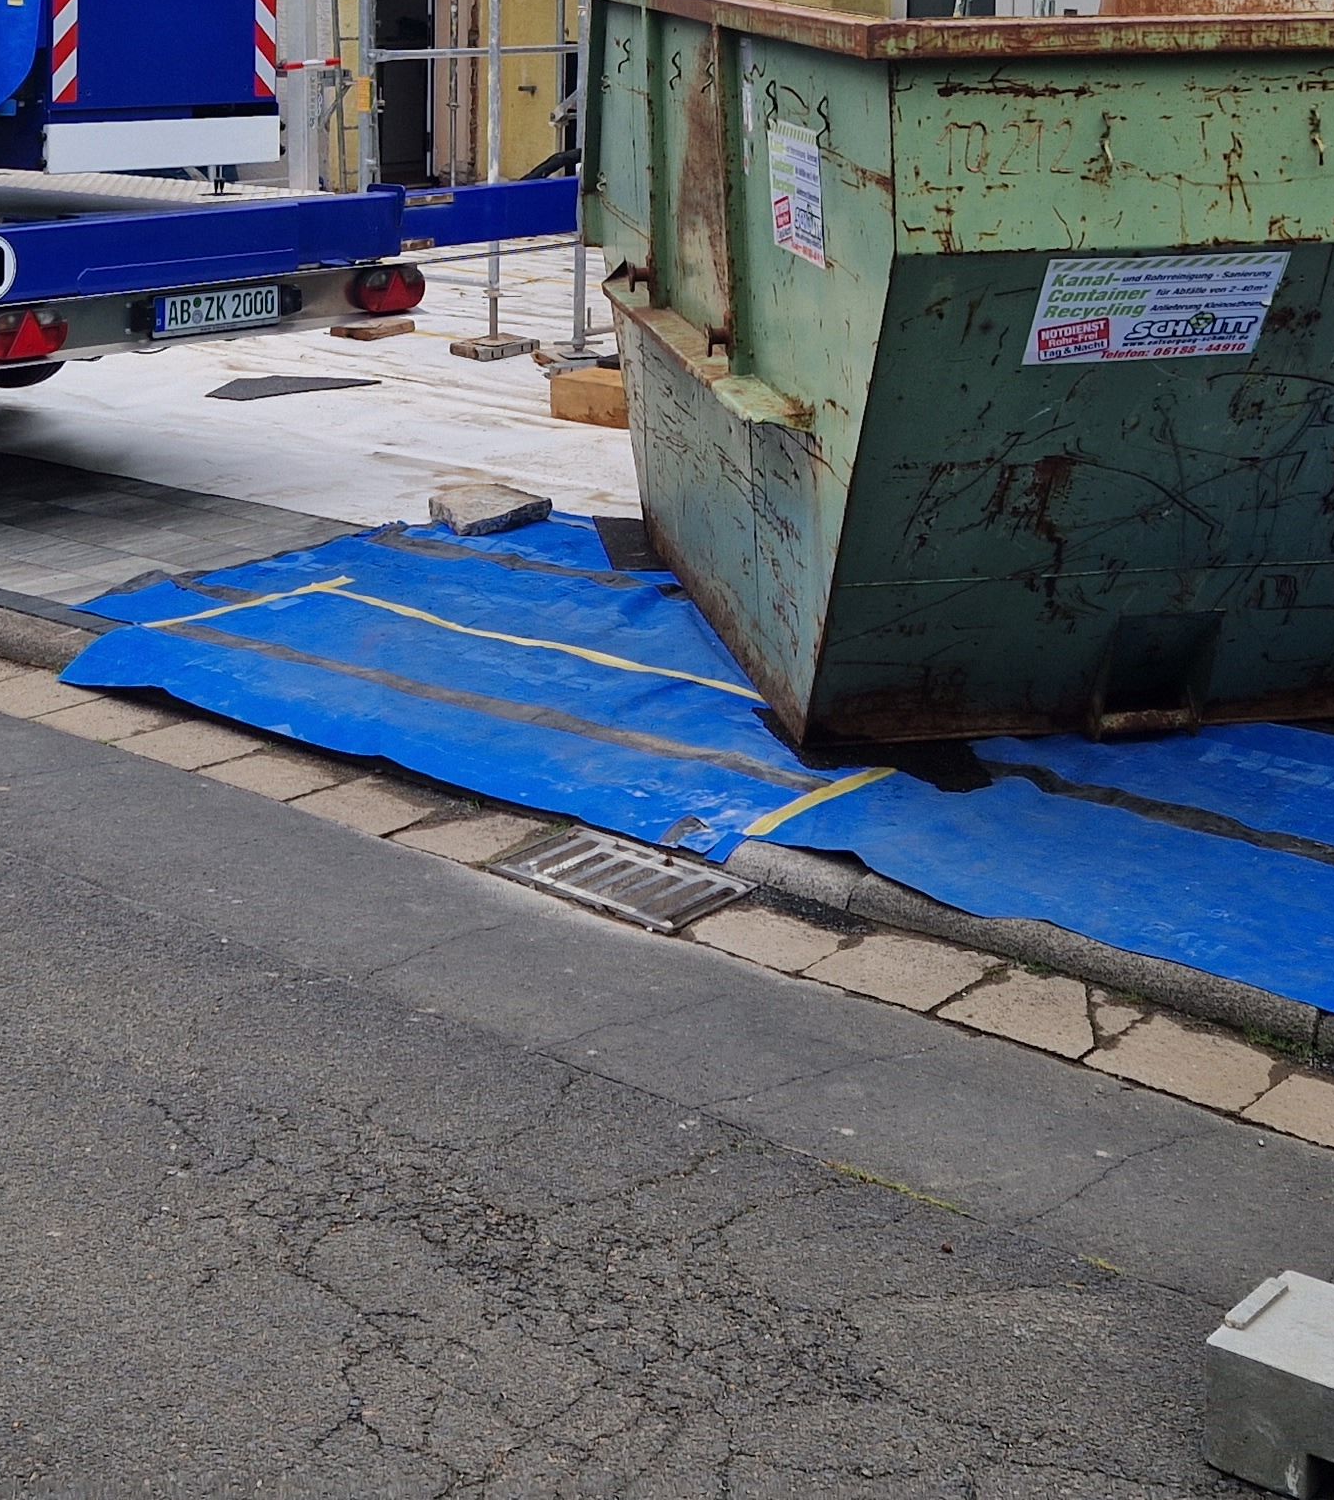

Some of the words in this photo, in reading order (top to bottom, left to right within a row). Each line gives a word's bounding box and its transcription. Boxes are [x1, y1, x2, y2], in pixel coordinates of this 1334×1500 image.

[1052, 273, 1120, 287] Kanal-
[1122, 274, 1141, 283] und
[1144, 272, 1213, 282] Rohrreinigung
[1221, 269, 1272, 279] Sanierung
[1047, 287, 1151, 303] Container
[1155, 288, 1170, 296] für
[1173, 286, 1207, 295] Abfälle
[168, 299, 191, 326] AB
[204, 294, 227, 322] ZK
[232, 289, 275, 319] 2000
[1043, 303, 1147, 320] Recycling
[1150, 303, 1201, 312] Anlieferung
[1041, 320, 1106, 340] NOTDIENST
[1124, 315, 1258, 341] SCHMITT
[1042, 347, 1062, 358] Tag
[1064, 345, 1072, 354] &
[1074, 340, 1104, 352] Nacht
[1048, 332, 1098, 348] Rohr-Frei
[1100, 349, 1150, 359] Telefon:
